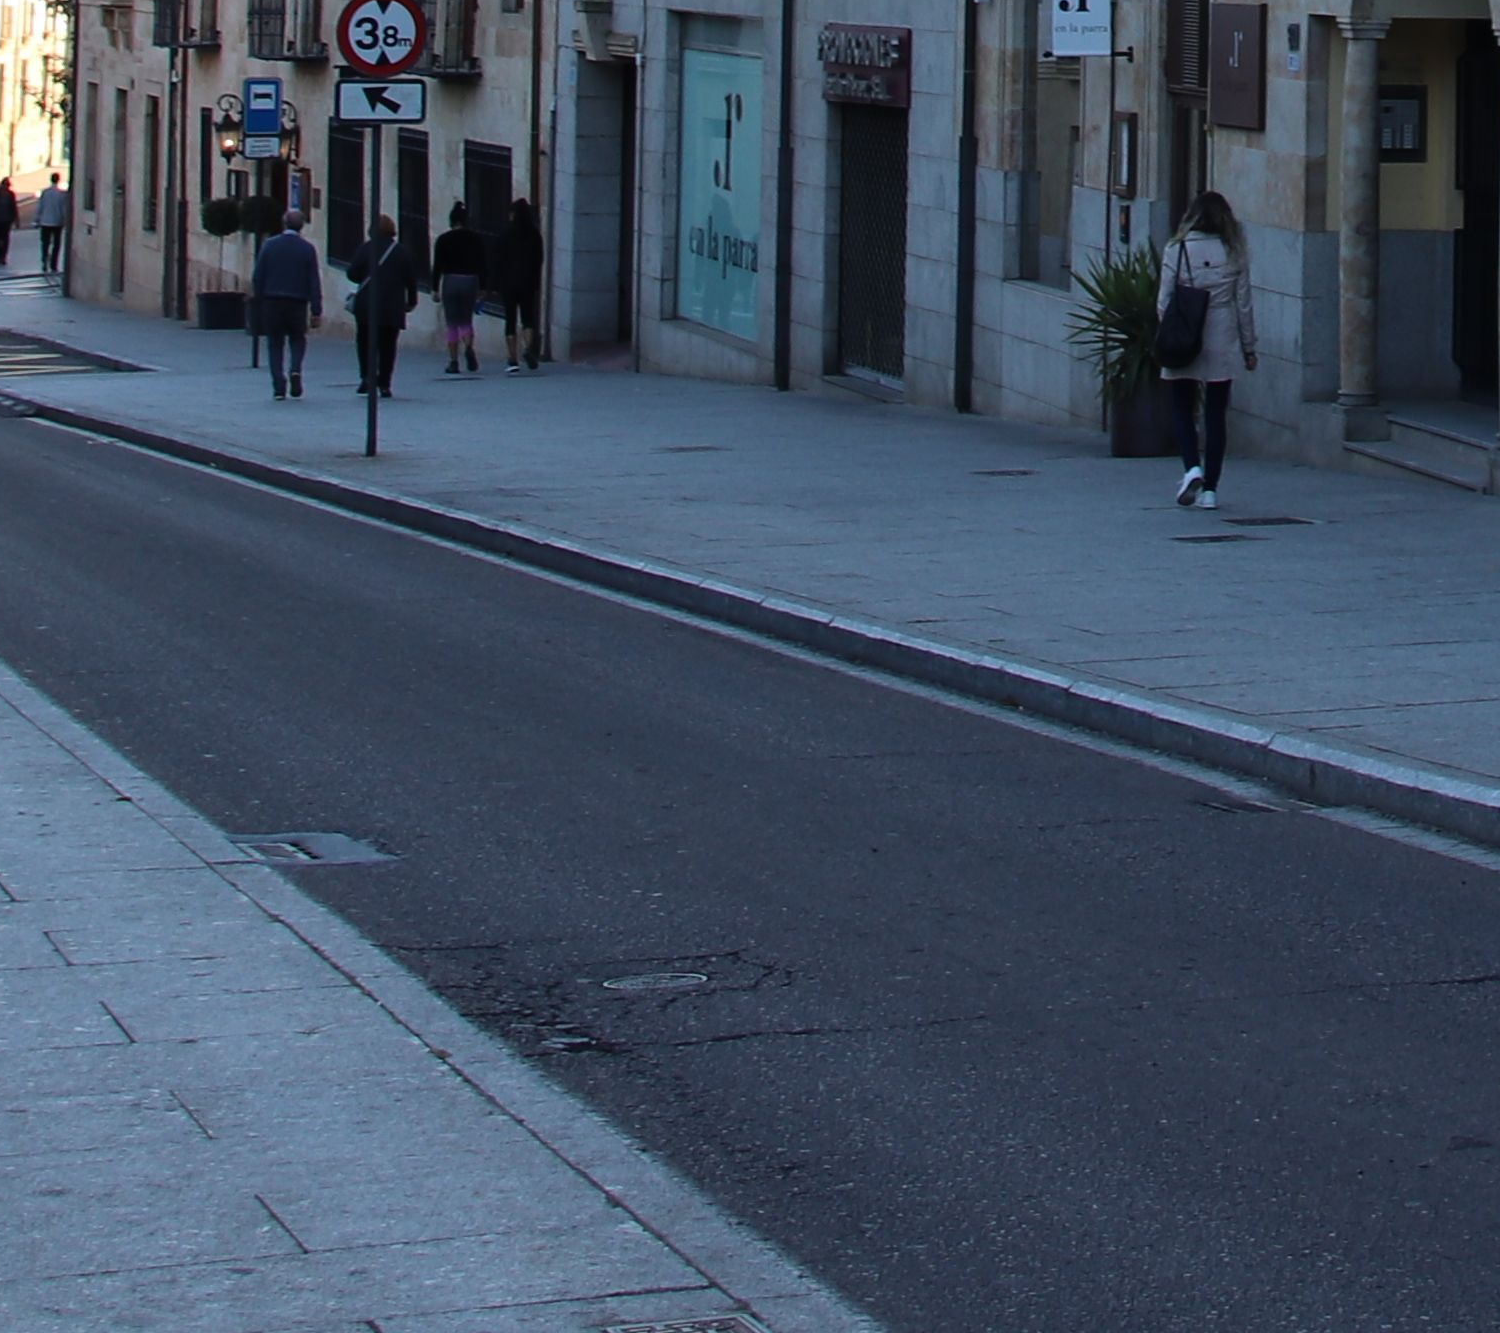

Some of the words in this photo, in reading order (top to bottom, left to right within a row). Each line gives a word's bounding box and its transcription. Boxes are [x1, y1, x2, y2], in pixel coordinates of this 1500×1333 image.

[1069, 22, 1079, 33] la
[1081, 25, 1108, 35] parra
[689, 225, 705, 257] en
[707, 215, 719, 261] la
[721, 235, 759, 280] parra
